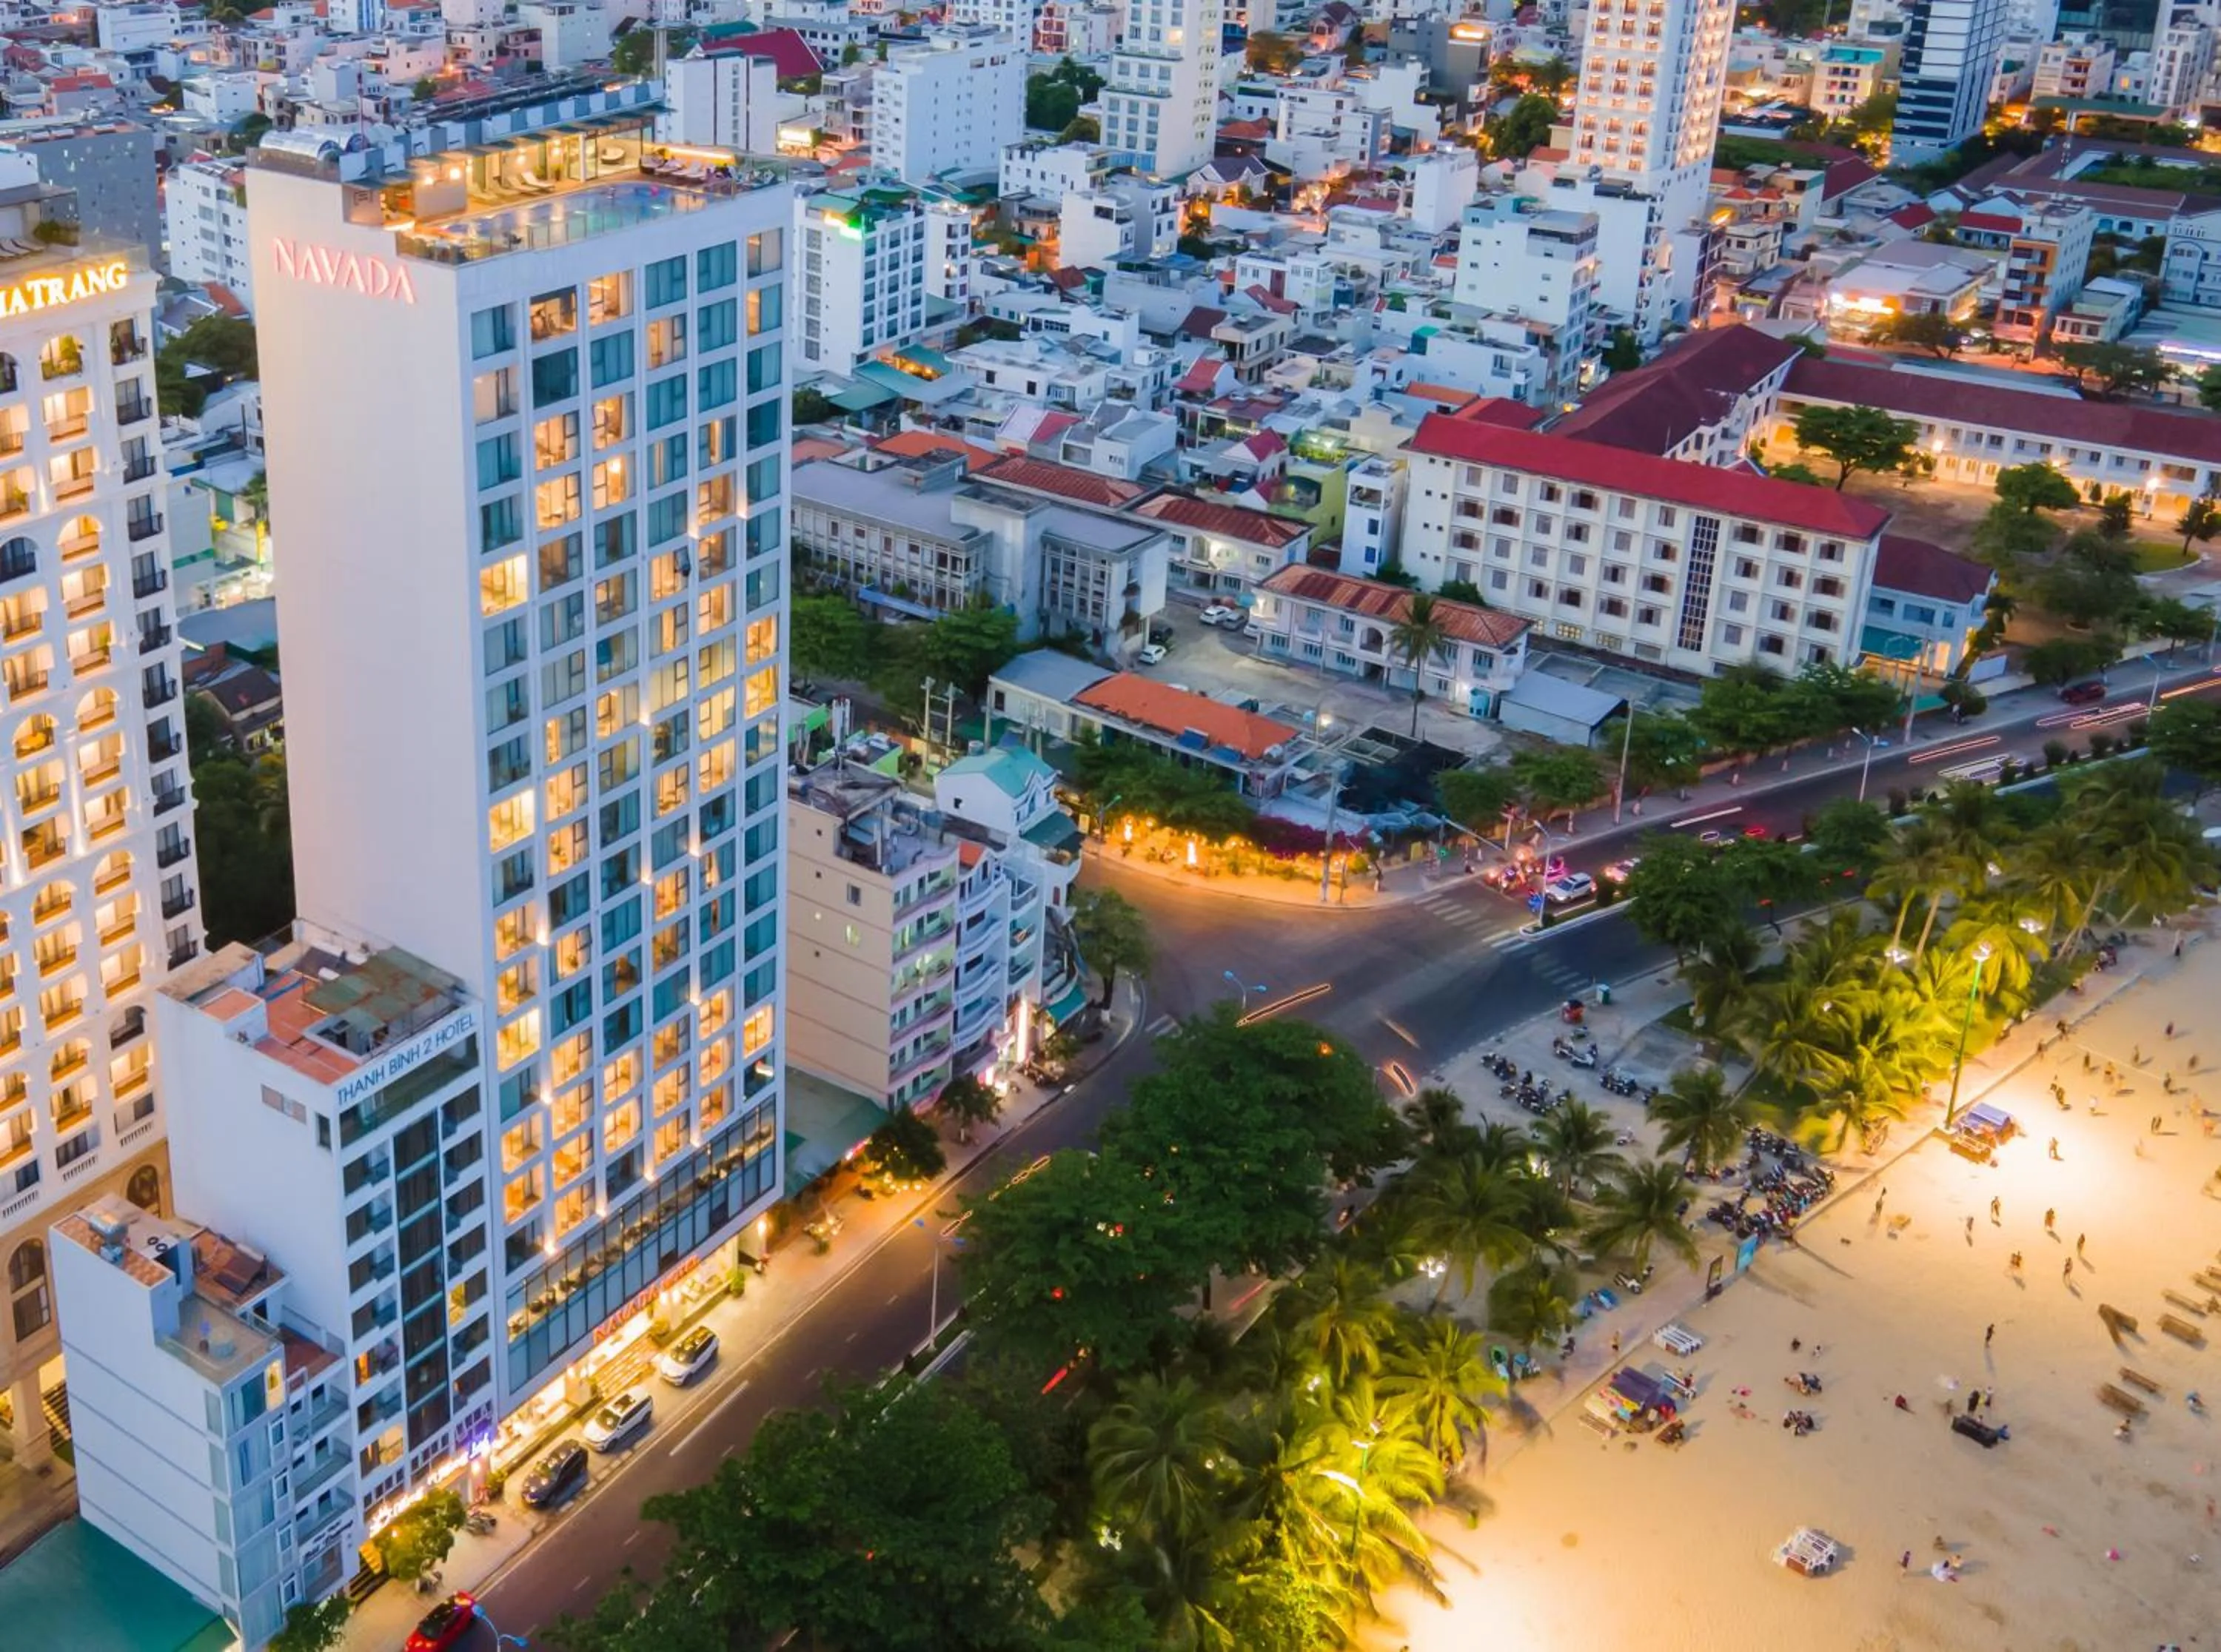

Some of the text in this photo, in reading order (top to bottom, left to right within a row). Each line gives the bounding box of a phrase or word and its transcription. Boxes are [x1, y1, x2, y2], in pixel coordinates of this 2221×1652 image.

[274, 237, 415, 304] NAVADA
[338, 1065, 385, 1106] THANH
[423, 1038, 432, 1055] 2
[436, 1013, 474, 1047] HOTEL
